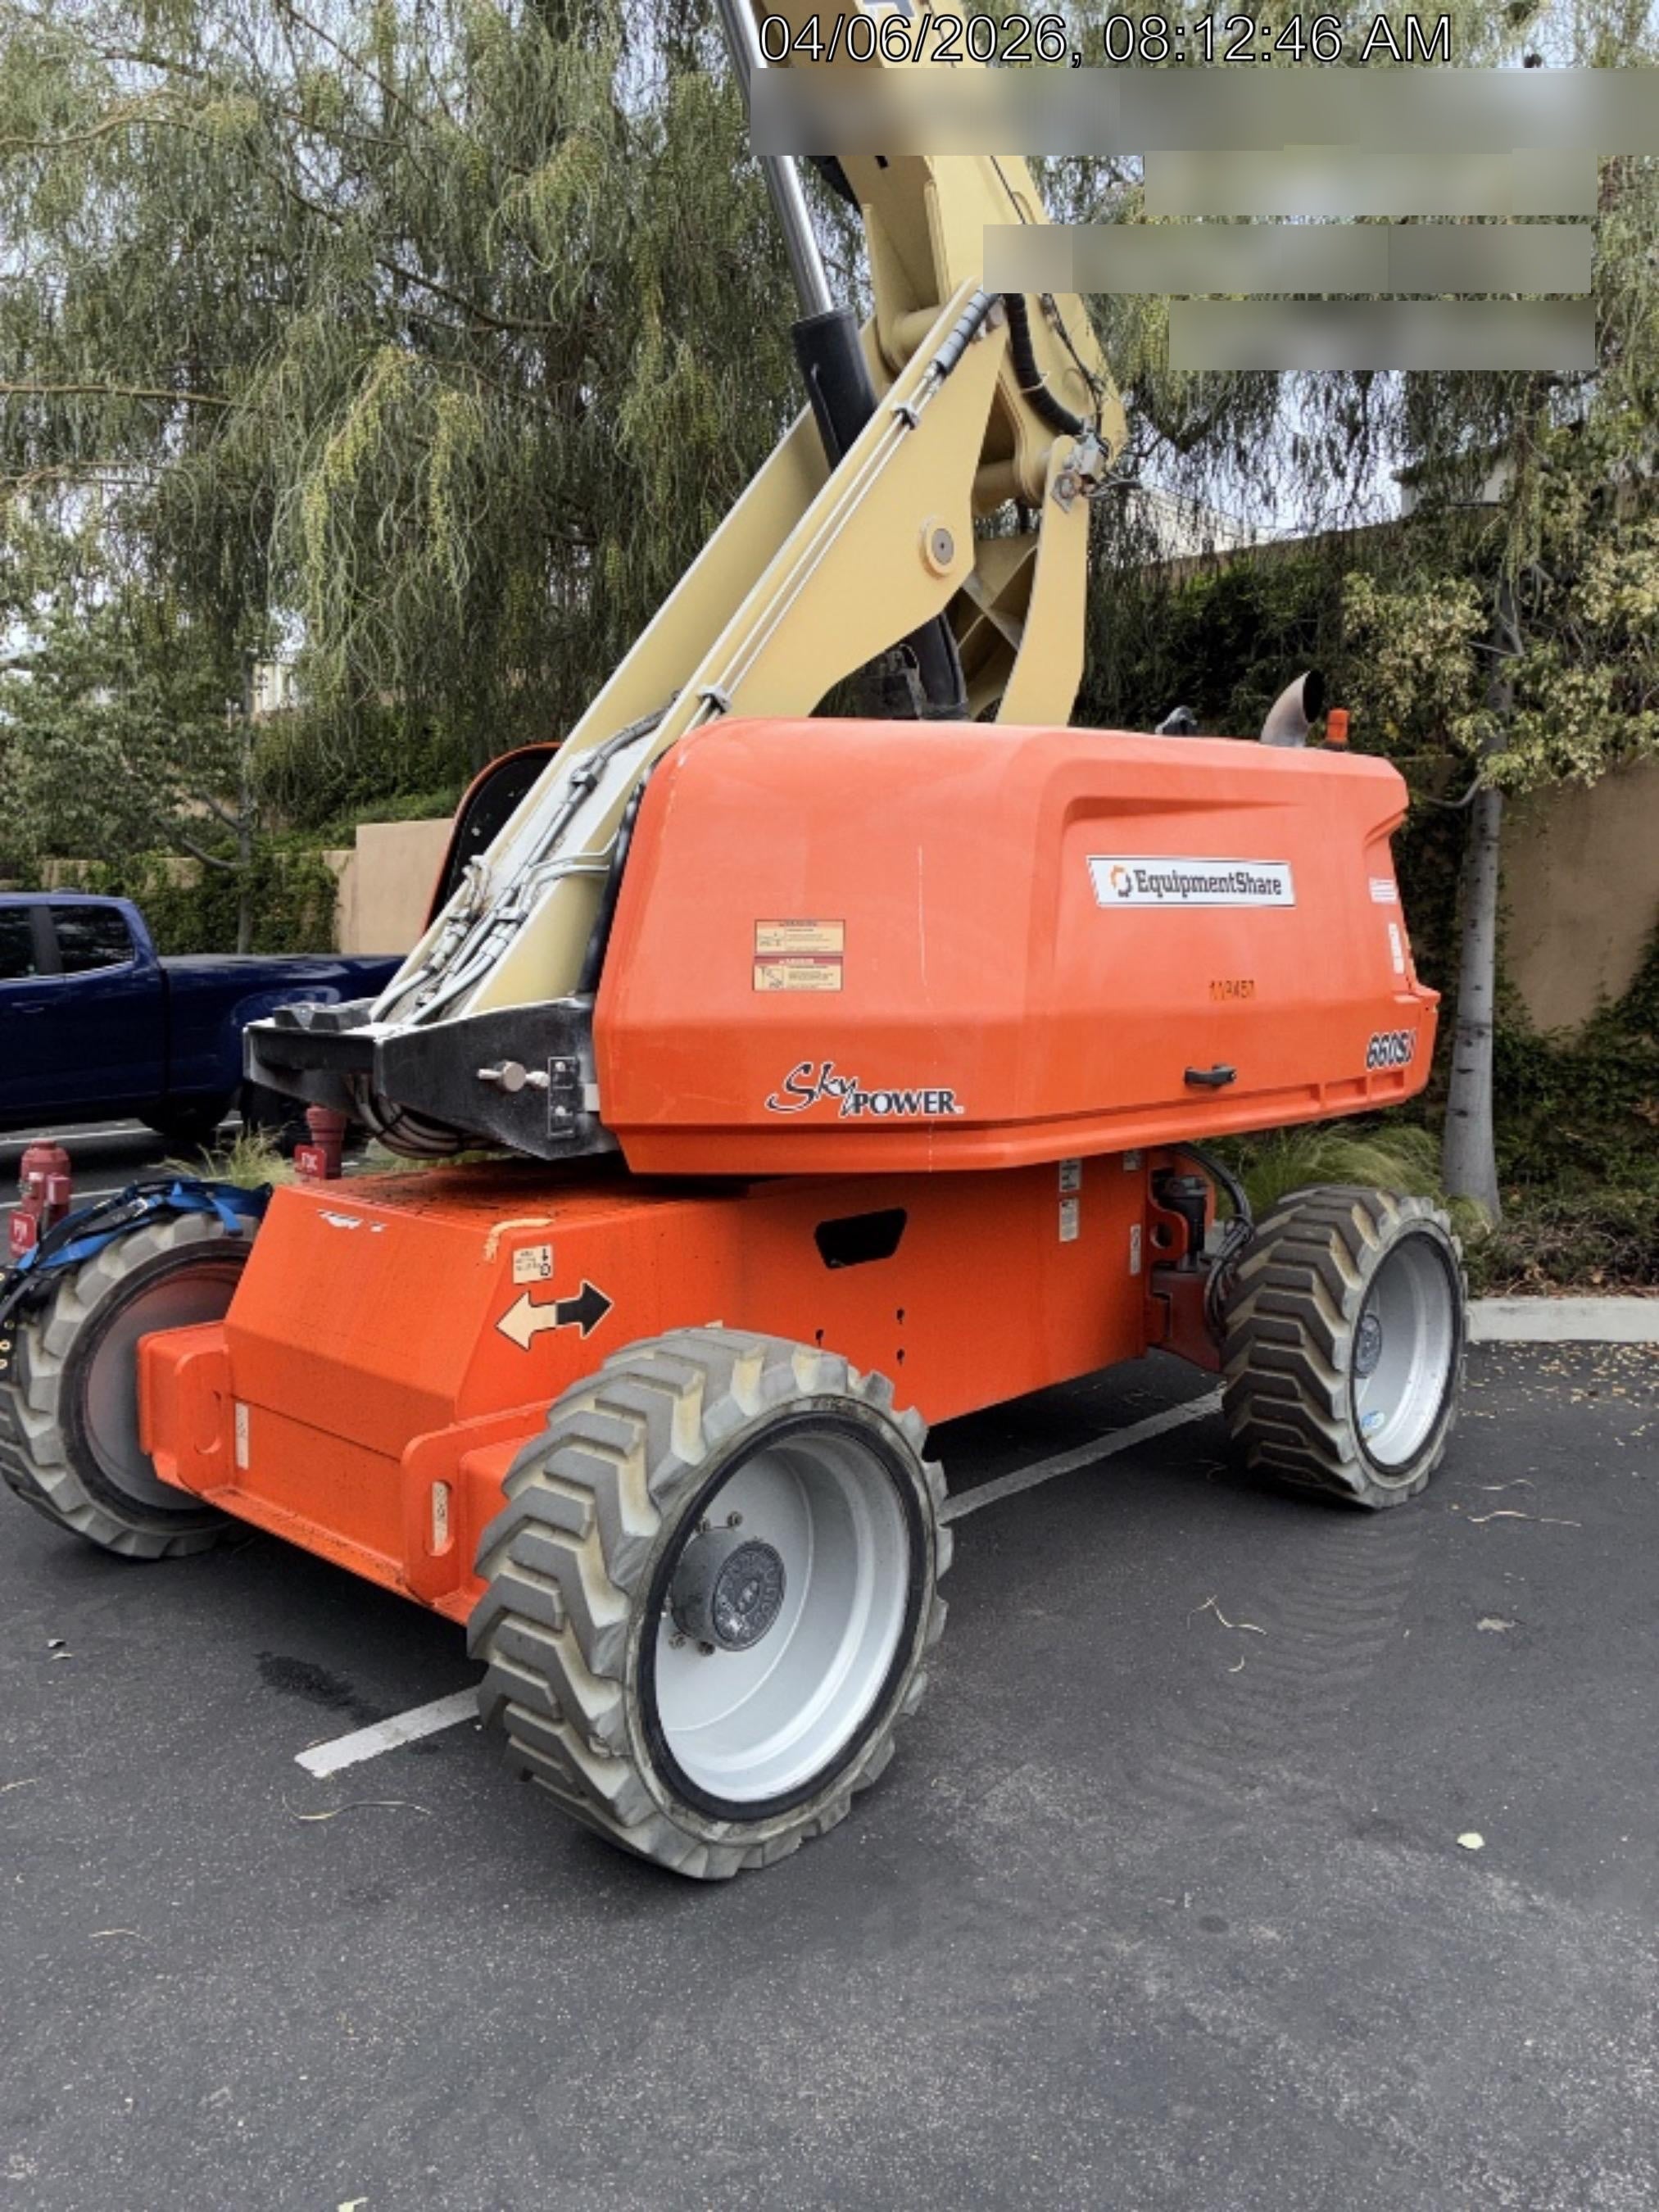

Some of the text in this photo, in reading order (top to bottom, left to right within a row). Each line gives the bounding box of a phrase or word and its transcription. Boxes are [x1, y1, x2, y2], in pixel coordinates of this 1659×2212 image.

[1133, 868, 1282, 898] EquipmentShare
[765, 1062, 957, 1118] Sky POWER
